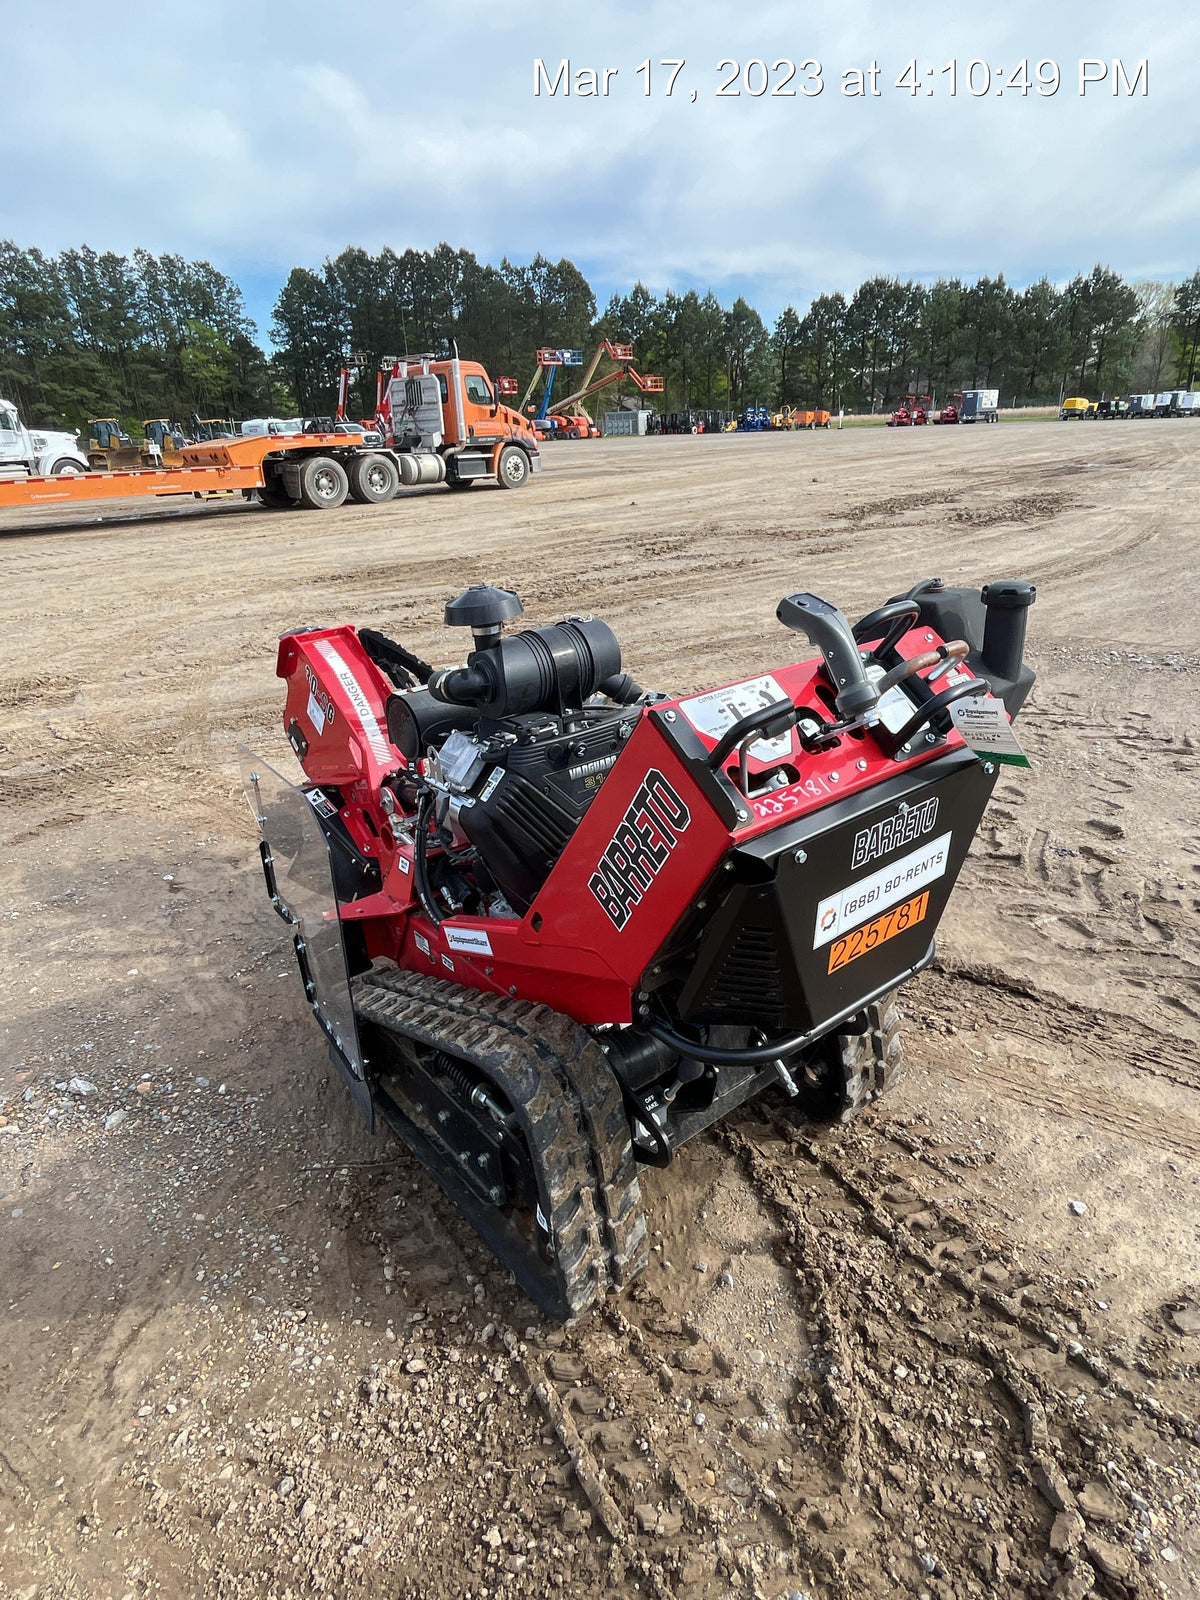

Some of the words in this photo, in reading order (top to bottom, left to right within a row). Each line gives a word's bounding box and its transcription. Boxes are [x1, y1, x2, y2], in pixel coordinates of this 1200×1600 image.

[339, 671, 370, 717] DANGER
[568, 755, 617, 781] VANGUARD
[753, 776, 832, 817] 225781
[587, 768, 691, 932] BARRETO
[851, 796, 940, 871] BARRETO
[843, 885, 880, 918] (888)
[884, 850, 944, 894] 80-RENTS
[830, 894, 925, 972] 225781
